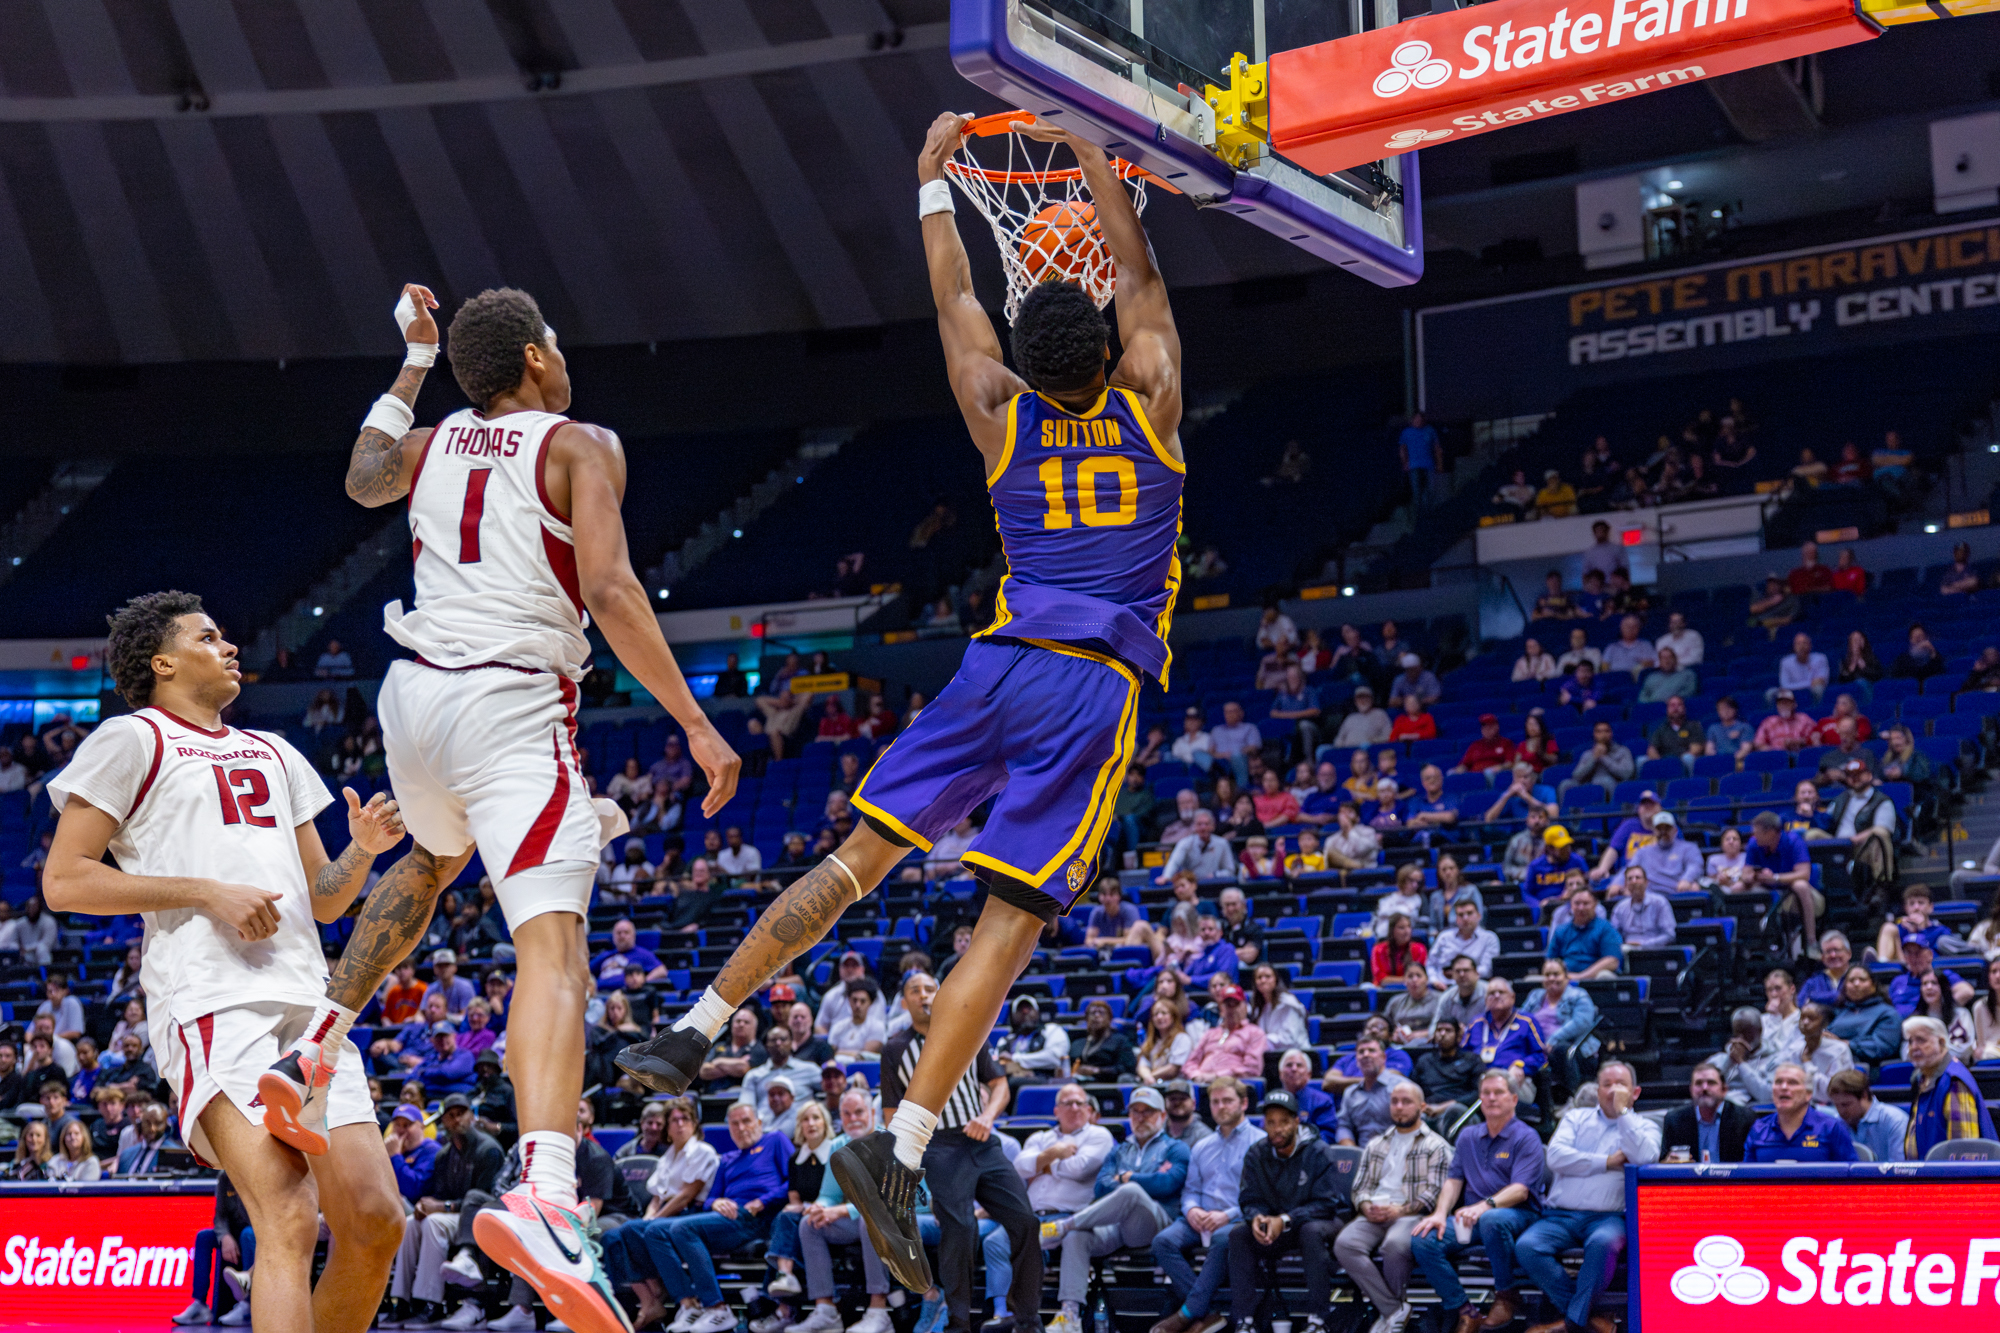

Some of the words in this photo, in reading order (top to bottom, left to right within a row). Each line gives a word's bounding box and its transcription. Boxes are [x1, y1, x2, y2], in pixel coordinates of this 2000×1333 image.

[1569, 274, 1708, 327] PETE
[1569, 299, 1821, 365] ASSEMBLY
[1836, 273, 2000, 327] CENTE
[1041, 418, 1122, 448] SUTTON
[458, 468, 493, 564] 1
[1039, 455, 1139, 530] 10
[211, 764, 278, 828] 12
[792, 901, 814, 923] AMEN
[807, 897, 820, 914] Play
[1269, 1092, 1289, 1103] YETI
